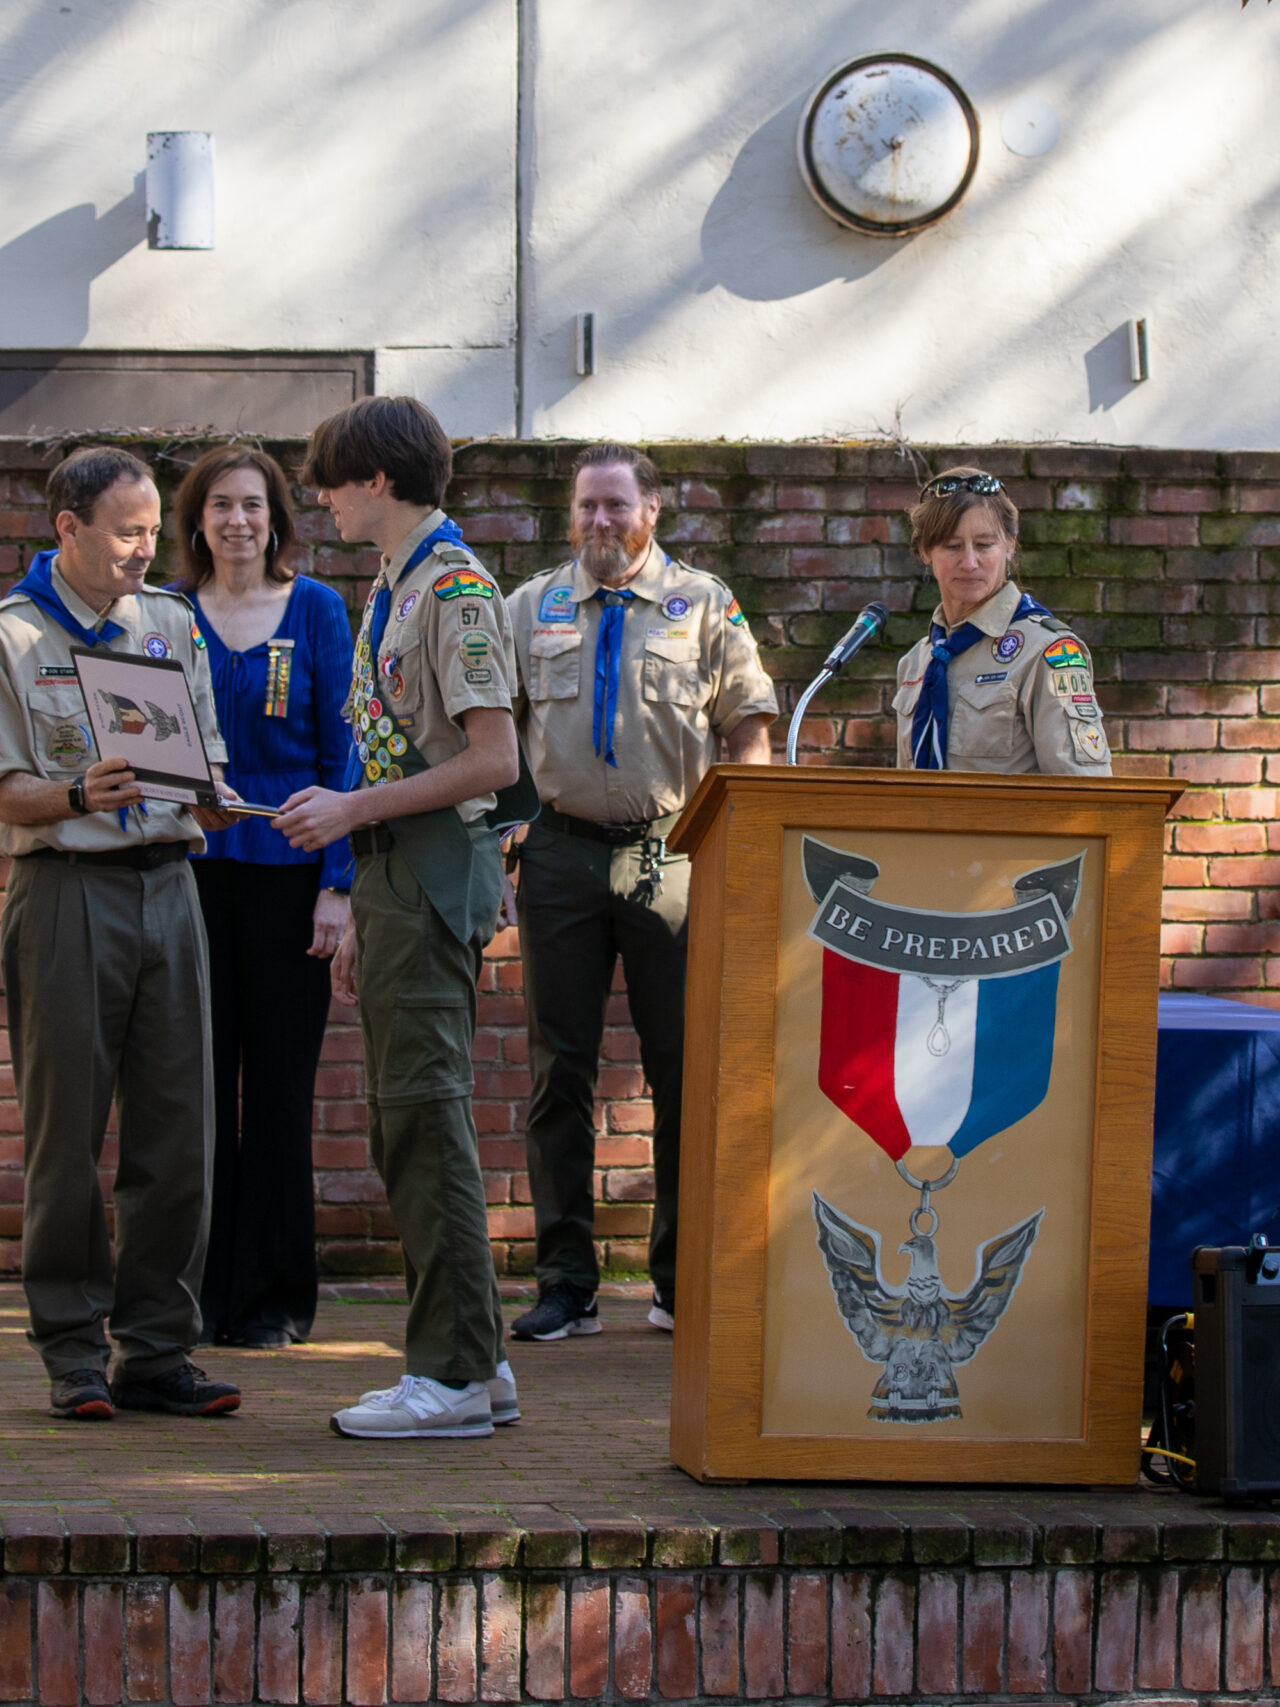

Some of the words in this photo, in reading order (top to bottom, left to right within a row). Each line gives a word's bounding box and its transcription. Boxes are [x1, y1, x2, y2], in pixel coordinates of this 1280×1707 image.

[462, 608, 480, 625] 57
[825, 903, 873, 941] BE
[880, 917, 1059, 960] PREPARED
